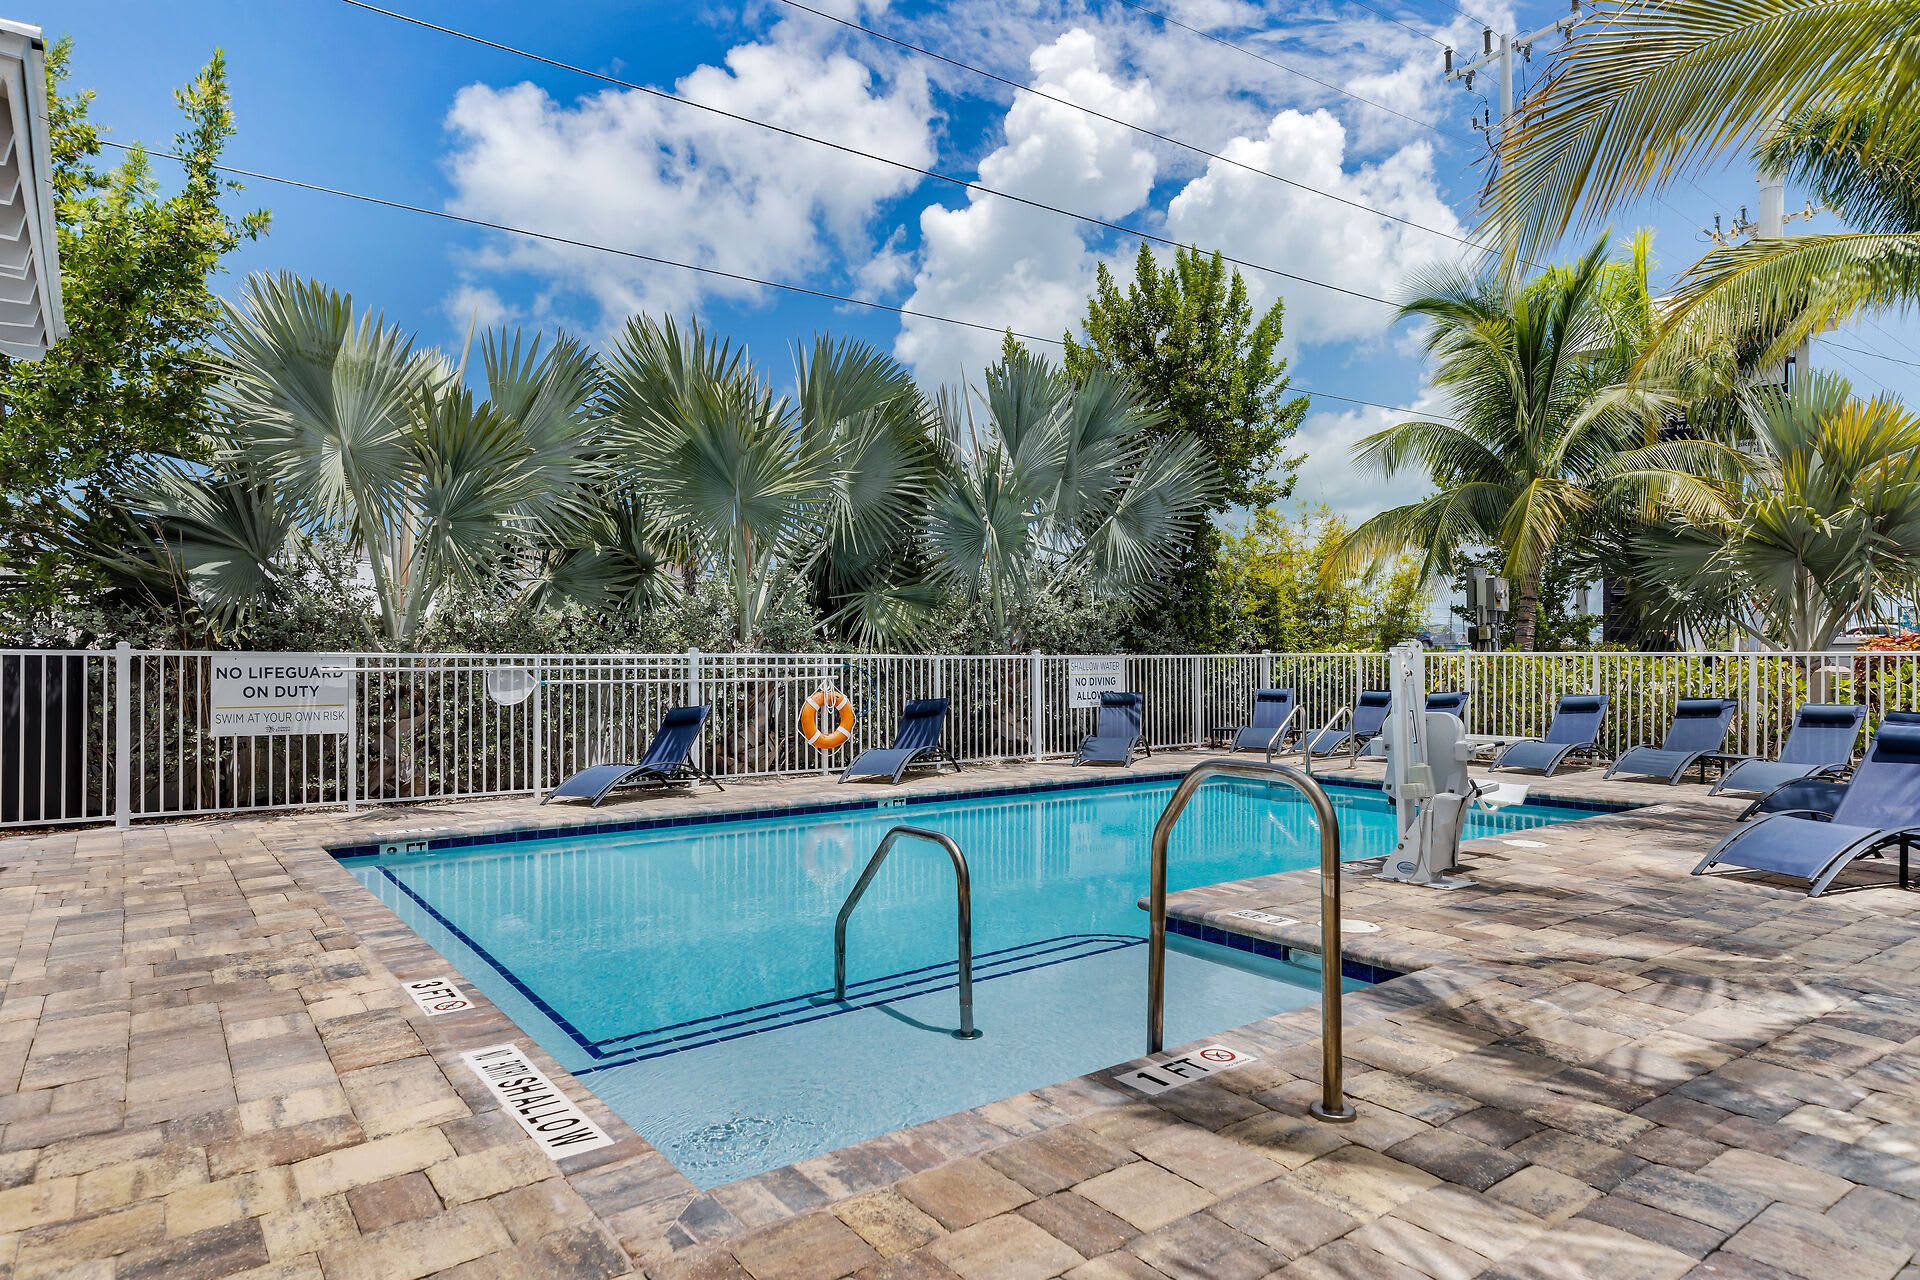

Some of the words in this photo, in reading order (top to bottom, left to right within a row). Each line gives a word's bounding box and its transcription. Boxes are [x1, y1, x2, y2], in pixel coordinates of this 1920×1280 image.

[216, 667, 242, 679] NO
[248, 666, 344, 679] LIFEGUARD
[1070, 662, 1099, 671] SHALLOW
[1100, 661, 1120, 671] WATER
[1075, 677, 1087, 686] NO
[1089, 676, 1116, 686] DIVING
[242, 686, 268, 698] ON
[274, 685, 319, 698] DUTY
[215, 713, 244, 724] SWIM
[247, 713, 260, 723] AT
[263, 712, 292, 722] YOUR
[295, 711, 320, 722] OWN
[323, 710, 345, 721] RISK
[411, 981, 444, 989] 3
[417, 988, 457, 1002] FT
[1136, 1071, 1170, 1087] 1
[1160, 1057, 1210, 1079] FT
[497, 1076, 599, 1148] SHALLOW
